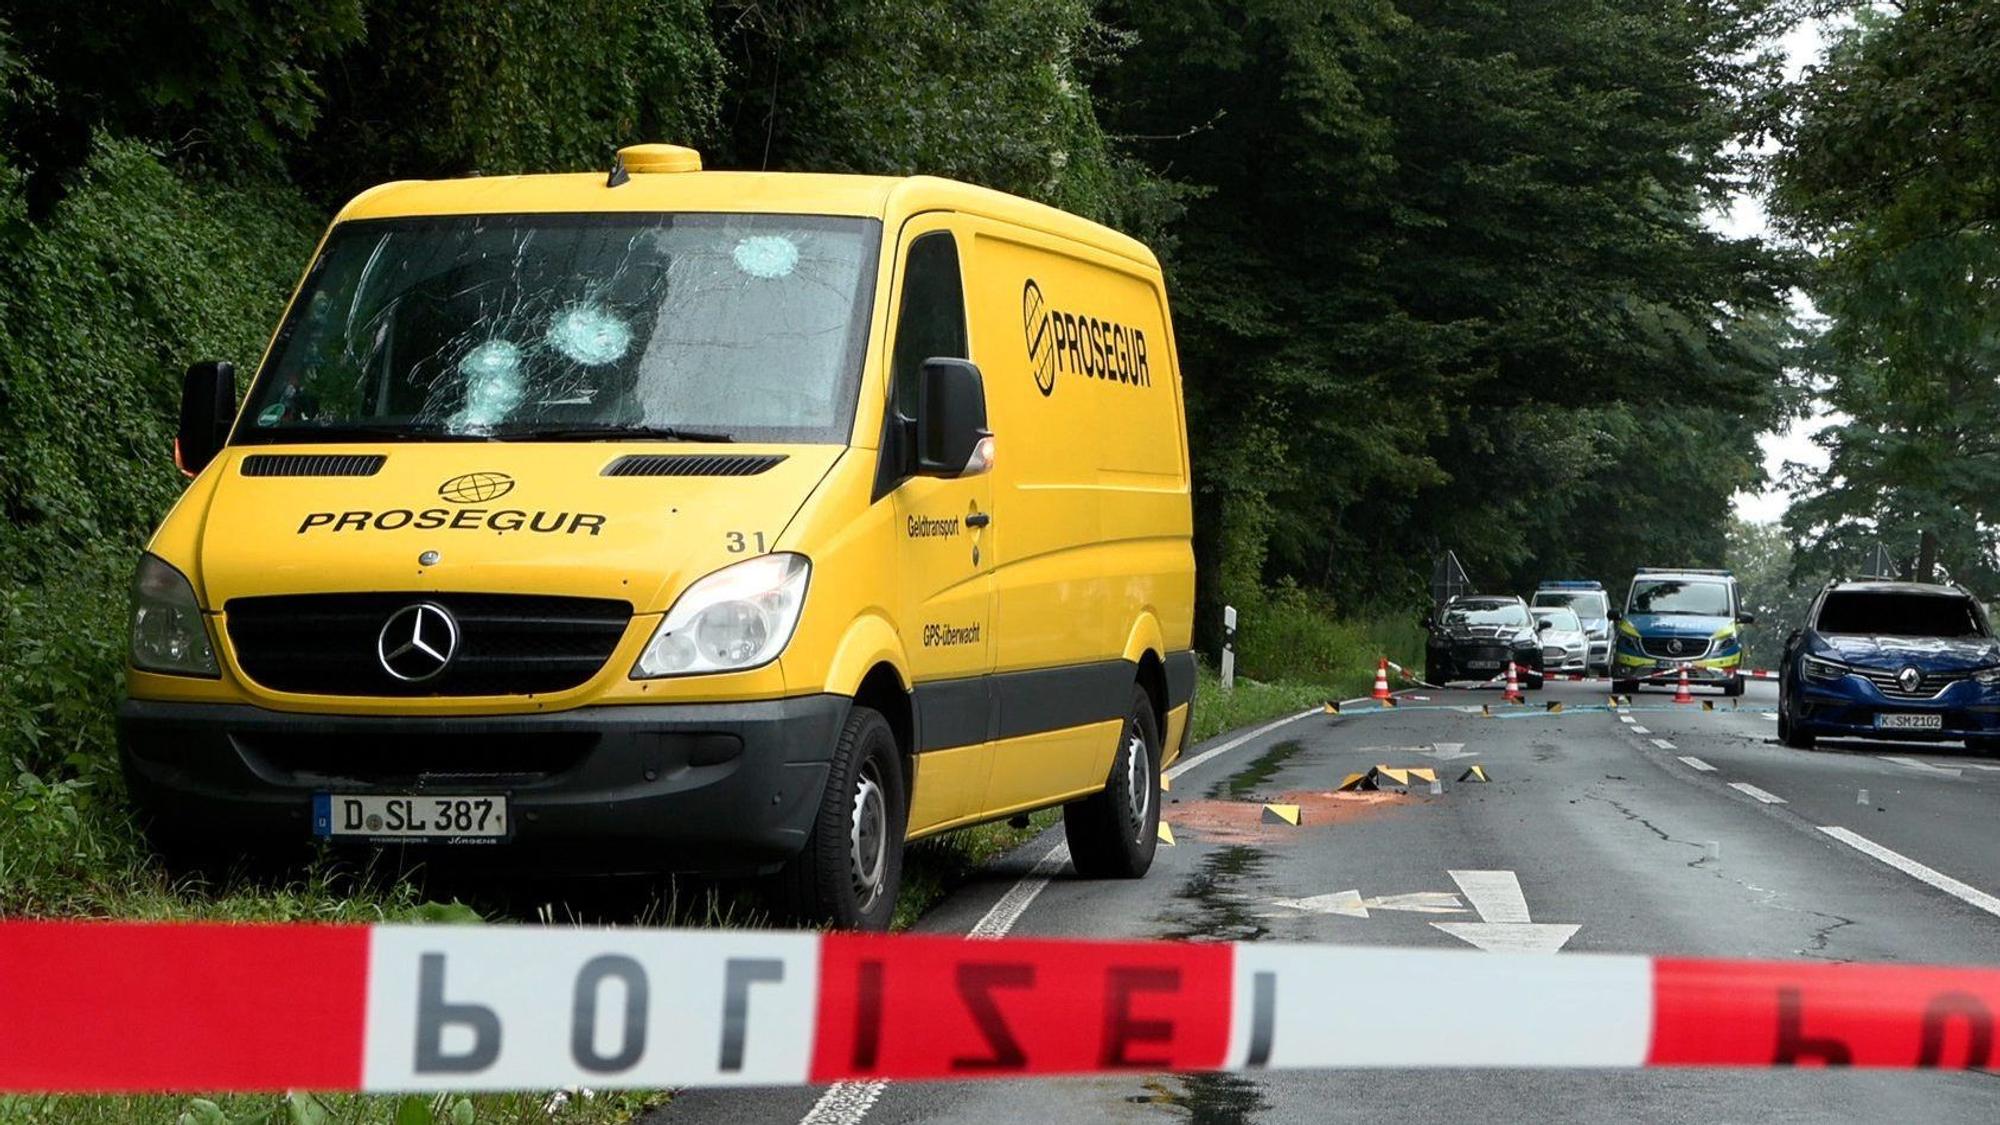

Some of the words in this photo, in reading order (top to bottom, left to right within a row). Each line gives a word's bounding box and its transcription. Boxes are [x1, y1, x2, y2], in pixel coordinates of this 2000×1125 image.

[1052, 309, 1151, 388] PROSEGUR
[297, 508, 607, 536] PROSEGUR
[907, 514, 959, 540] Geldtransport
[726, 531, 765, 553] 31
[923, 622, 980, 647] GPS-überwacht
[1881, 716, 1889, 727] K
[344, 800, 364, 831] D
[385, 799, 426, 832] SL
[434, 799, 494, 832] 387
